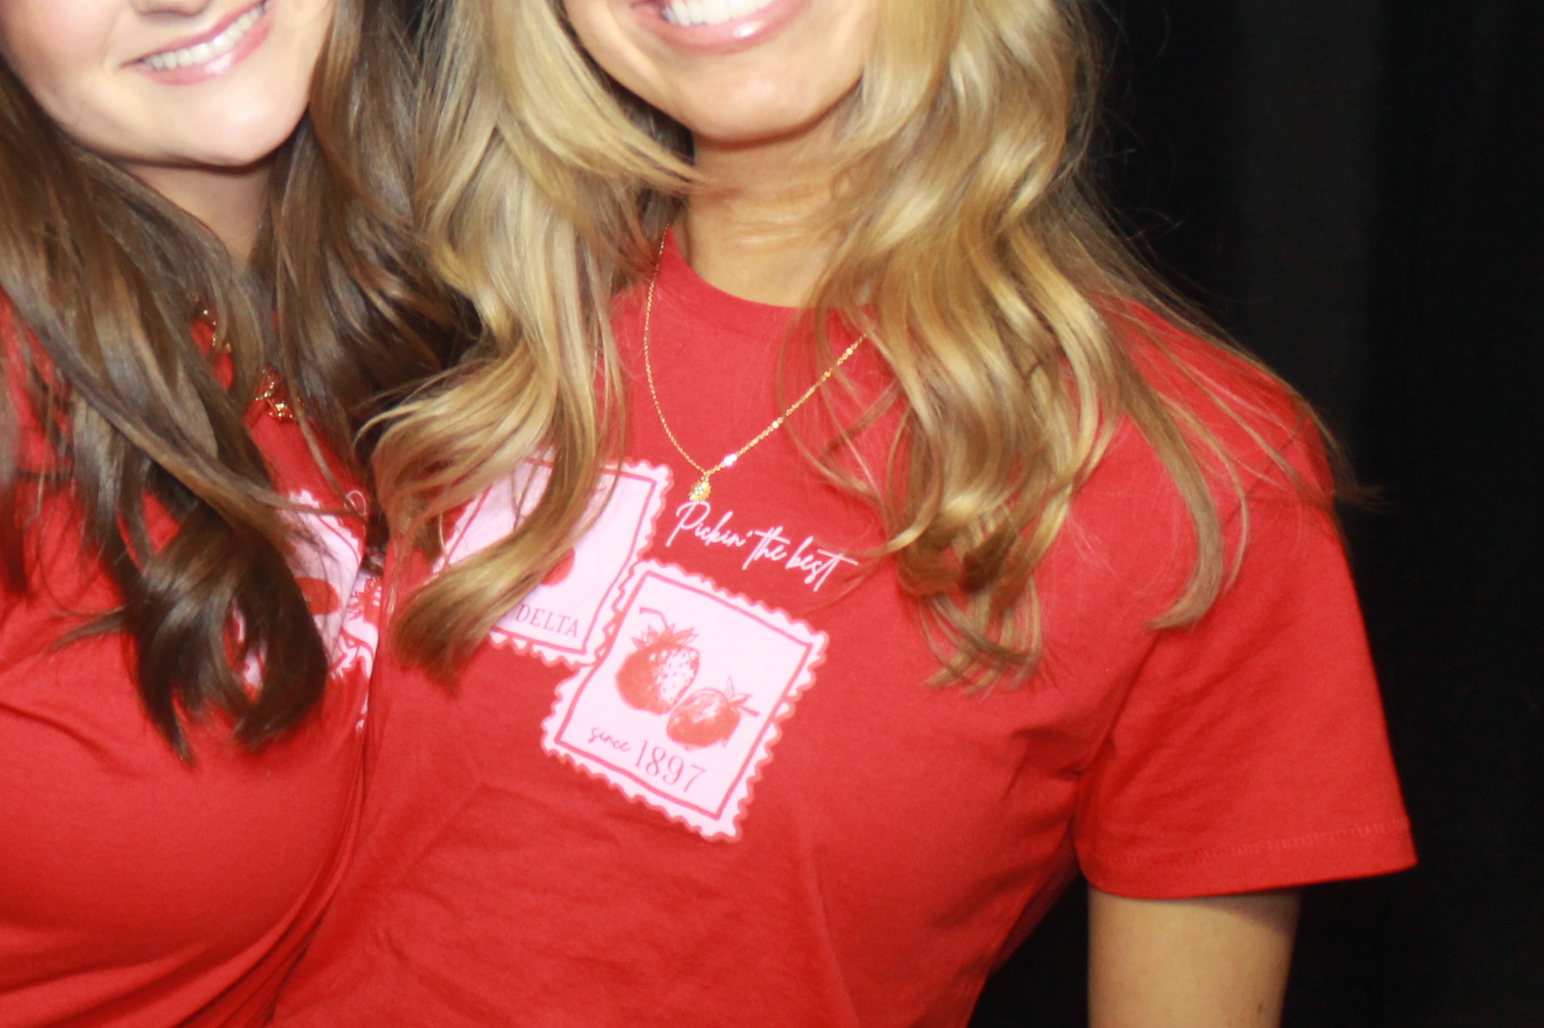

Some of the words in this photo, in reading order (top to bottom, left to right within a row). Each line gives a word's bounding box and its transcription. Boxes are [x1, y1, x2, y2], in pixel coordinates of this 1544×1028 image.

[742, 526, 791, 570] the
[786, 536, 859, 592] best
[515, 604, 578, 639] DELTA
[587, 727, 632, 752] since
[634, 739, 707, 793] 1897
